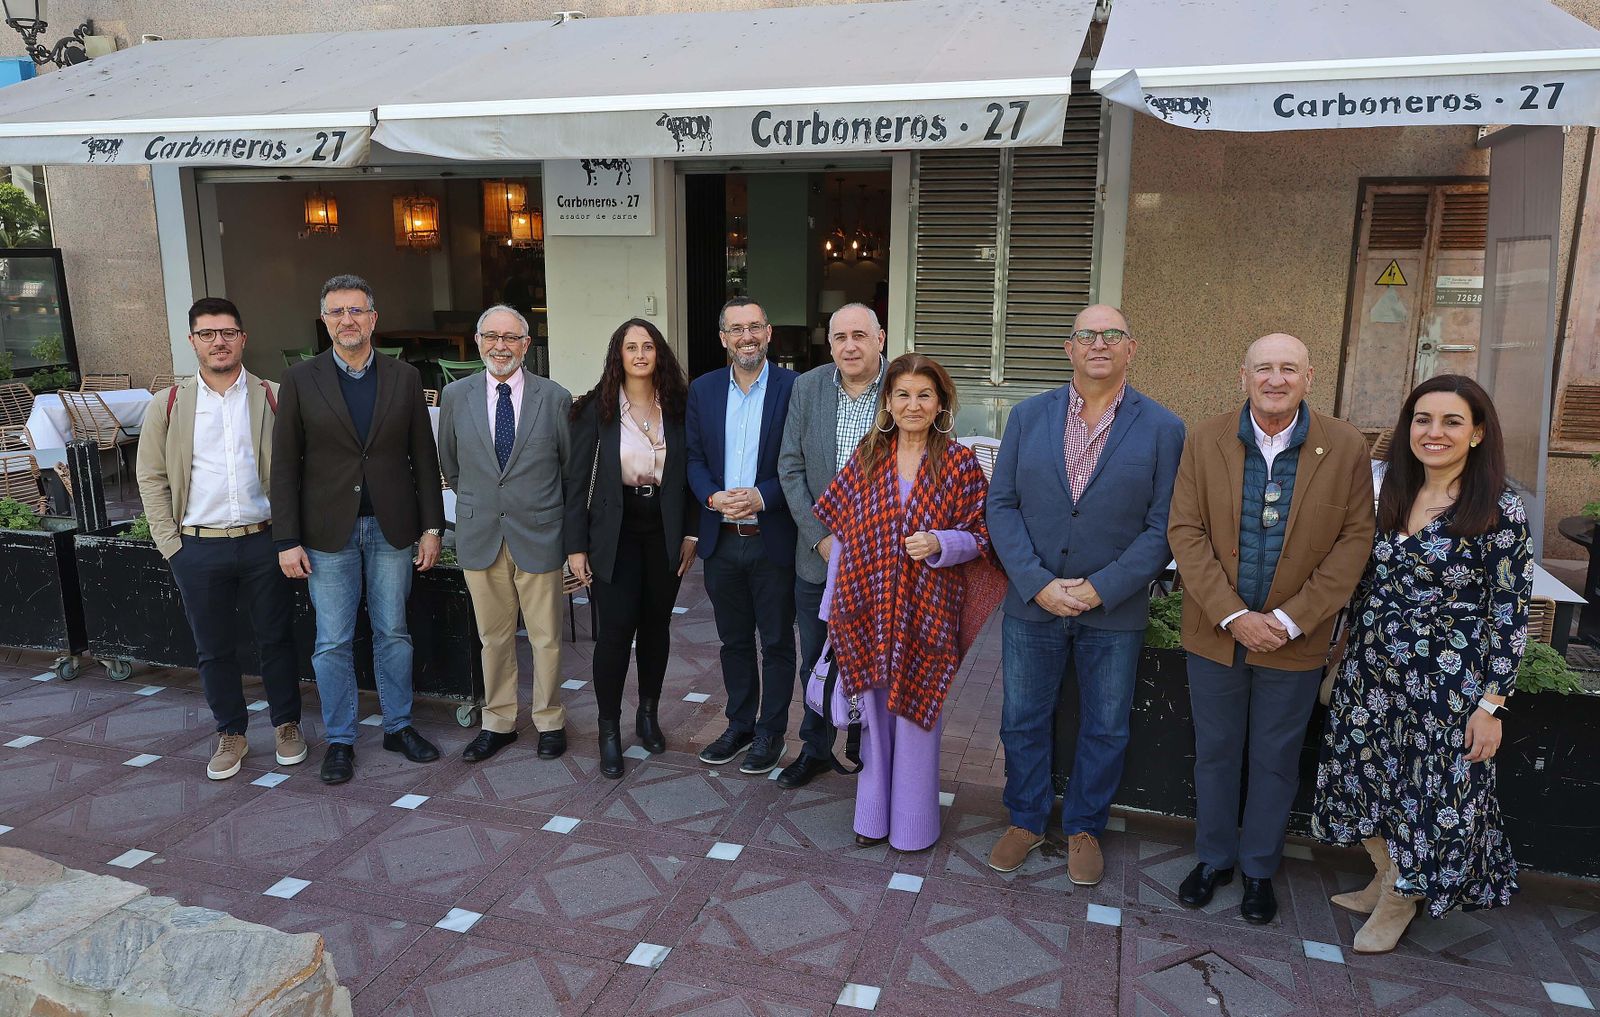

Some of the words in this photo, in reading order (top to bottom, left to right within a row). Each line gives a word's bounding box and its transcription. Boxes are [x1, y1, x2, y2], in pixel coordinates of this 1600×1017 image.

[1273, 91, 1482, 118] Carboneros
[1519, 82, 1565, 110] 27
[750, 110, 948, 148] Carboneros
[983, 100, 1030, 141] 27
[144, 135, 287, 160] Carboneros
[311, 130, 347, 161] 27
[556, 194, 618, 208] Carboneros
[627, 194, 640, 208] 27
